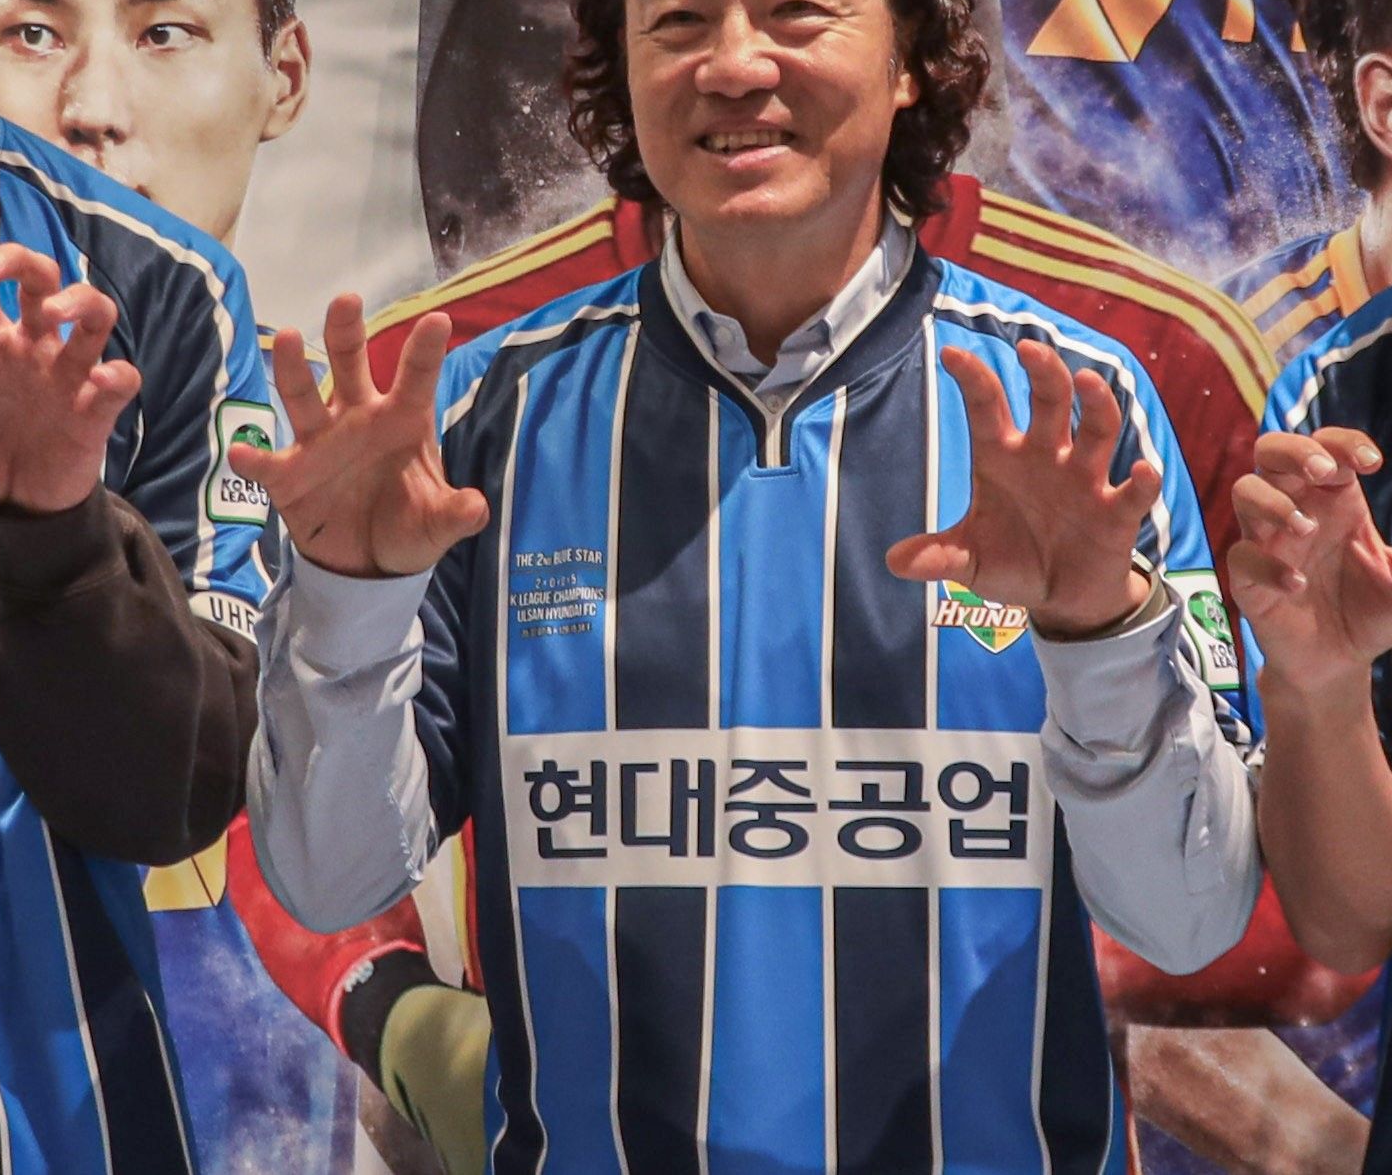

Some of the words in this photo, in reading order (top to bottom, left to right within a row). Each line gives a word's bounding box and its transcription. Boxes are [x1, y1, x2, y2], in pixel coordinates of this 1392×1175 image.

[220, 489, 269, 506] LEAGU
[516, 553, 534, 567] THE
[575, 548, 603, 564] STAR
[519, 591, 550, 606] LEAGUE
[553, 587, 604, 603] CHAMPIONS
[517, 607, 544, 622] ULSAN
[545, 603, 582, 619] HYUNDAI
[583, 602, 597, 616] FC
[932, 600, 1029, 628] HYUND
[524, 759, 1031, 859] 현대중공업
